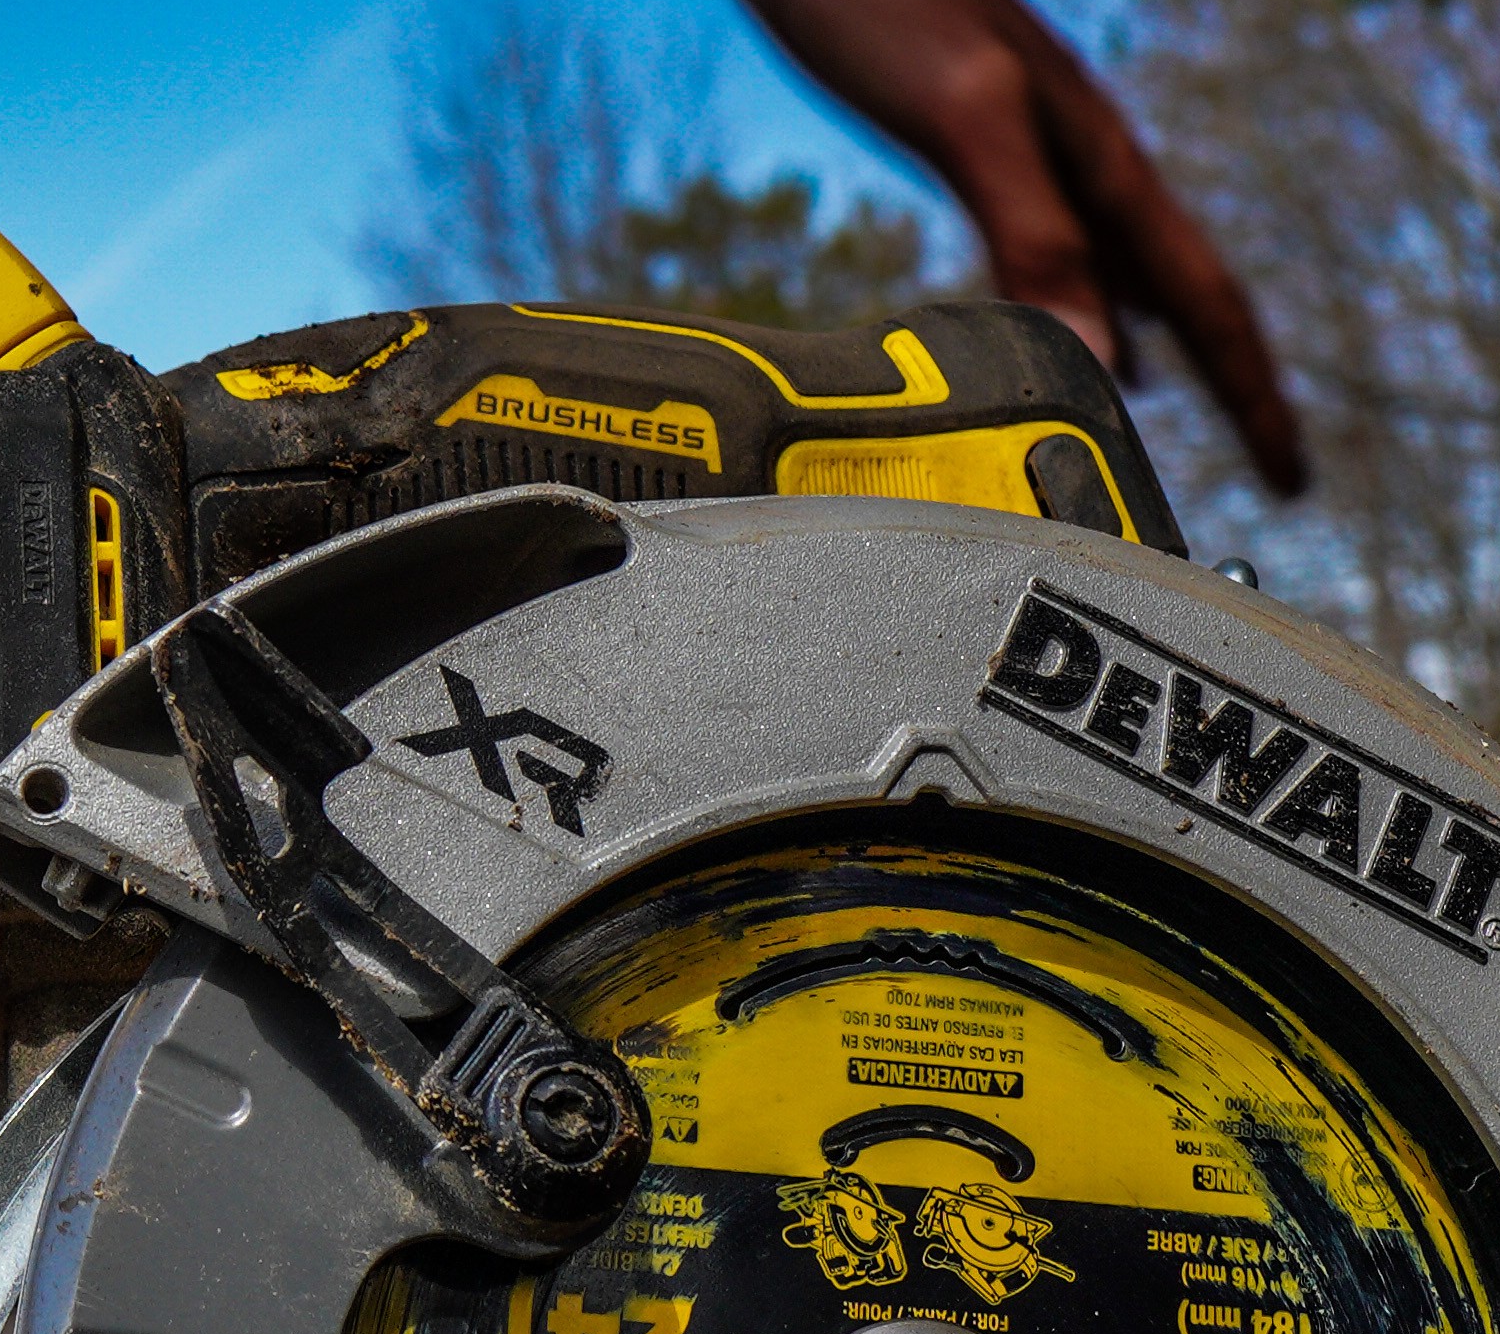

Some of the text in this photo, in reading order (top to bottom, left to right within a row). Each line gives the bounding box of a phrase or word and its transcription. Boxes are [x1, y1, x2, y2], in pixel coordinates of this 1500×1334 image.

[475, 391, 705, 451] BRUSHLESS
[394, 663, 615, 839] XR
[886, 989, 920, 1007] 7000
[874, 1012, 891, 1028] DE
[896, 1015, 938, 1032] ANTES
[841, 1033, 859, 1050] EN
[863, 1034, 965, 1059] ADVERTENCIAS
[1000, 1049, 1024, 1065] LEA
[849, 1058, 993, 1094] ADVERTENCIA:
[1175, 1138, 1202, 1157] FOR
[1146, 1229, 1203, 1255] ABRE
[1180, 1261, 1228, 1289] mm)
[842, 1300, 893, 1322] POUR:
[971, 1312, 1009, 1333] FOR:
